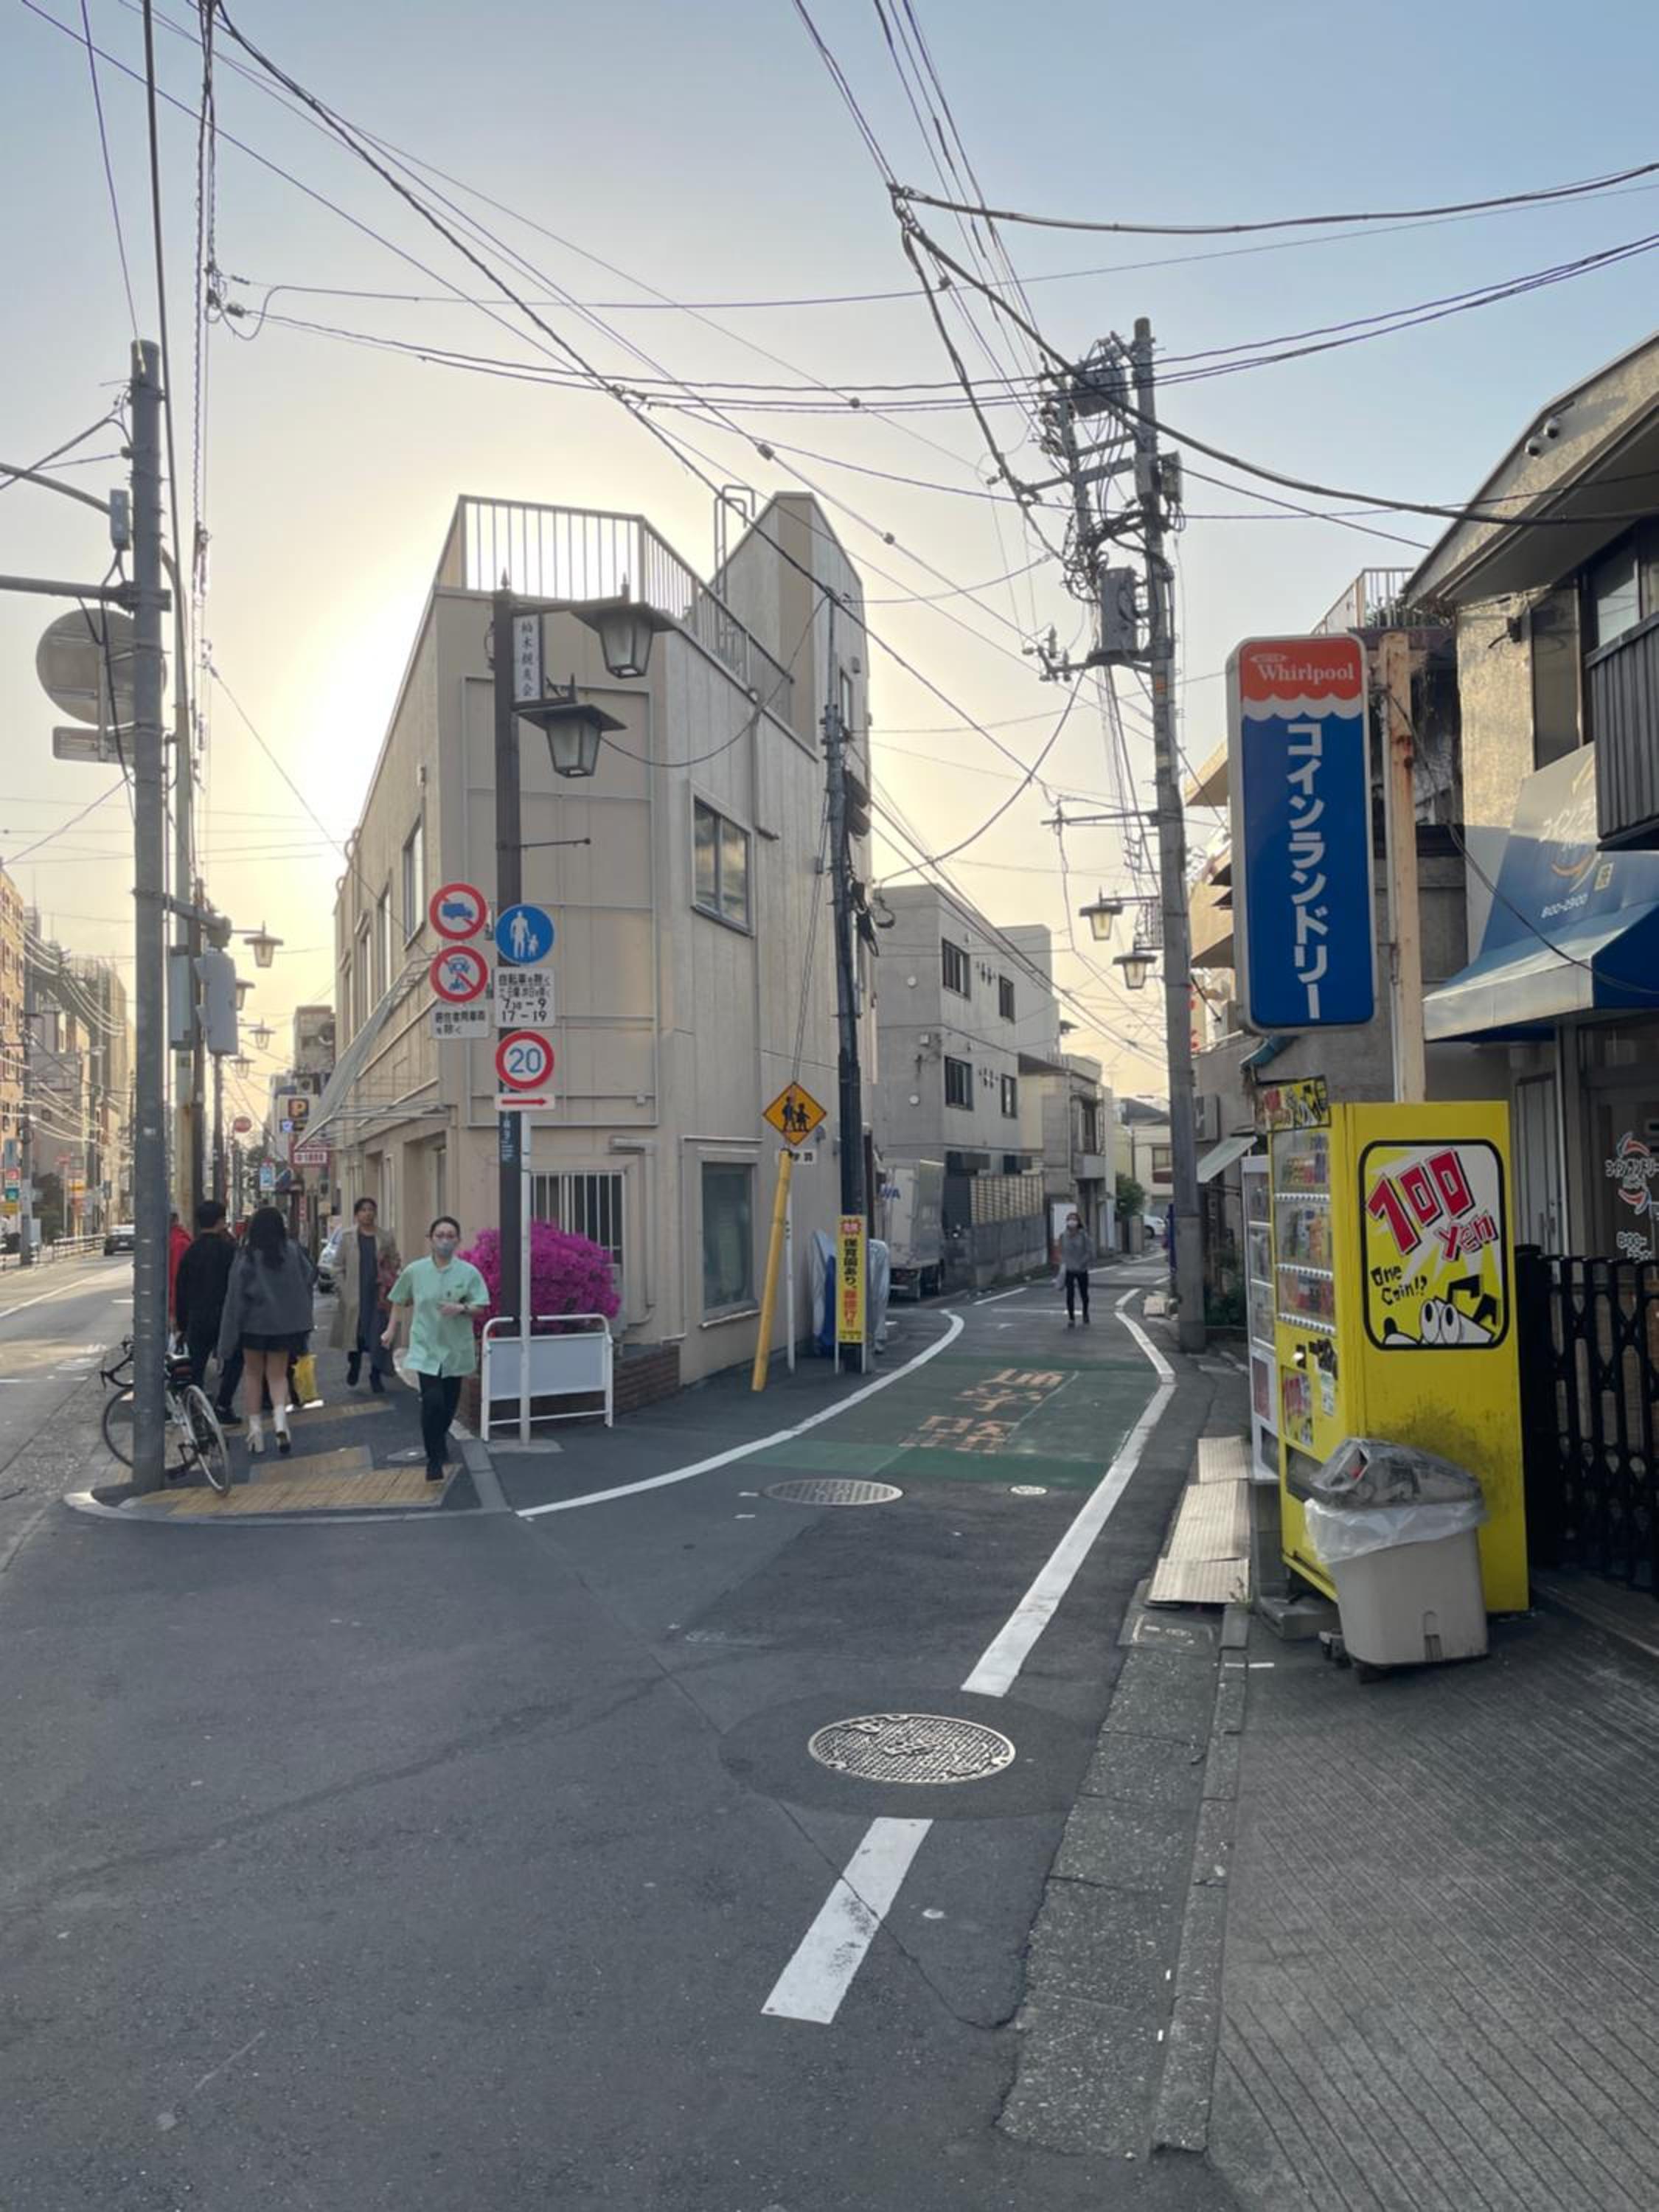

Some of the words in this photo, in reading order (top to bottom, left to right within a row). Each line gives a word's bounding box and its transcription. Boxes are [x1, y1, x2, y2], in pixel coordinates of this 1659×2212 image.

[1257, 662, 1354, 685] Whirlpool
[1287, 723, 1328, 1020] コインランドリー
[509, 1048, 542, 1074] 20
[1366, 1147, 1475, 1256] 100
[1370, 1264, 1403, 1288] One
